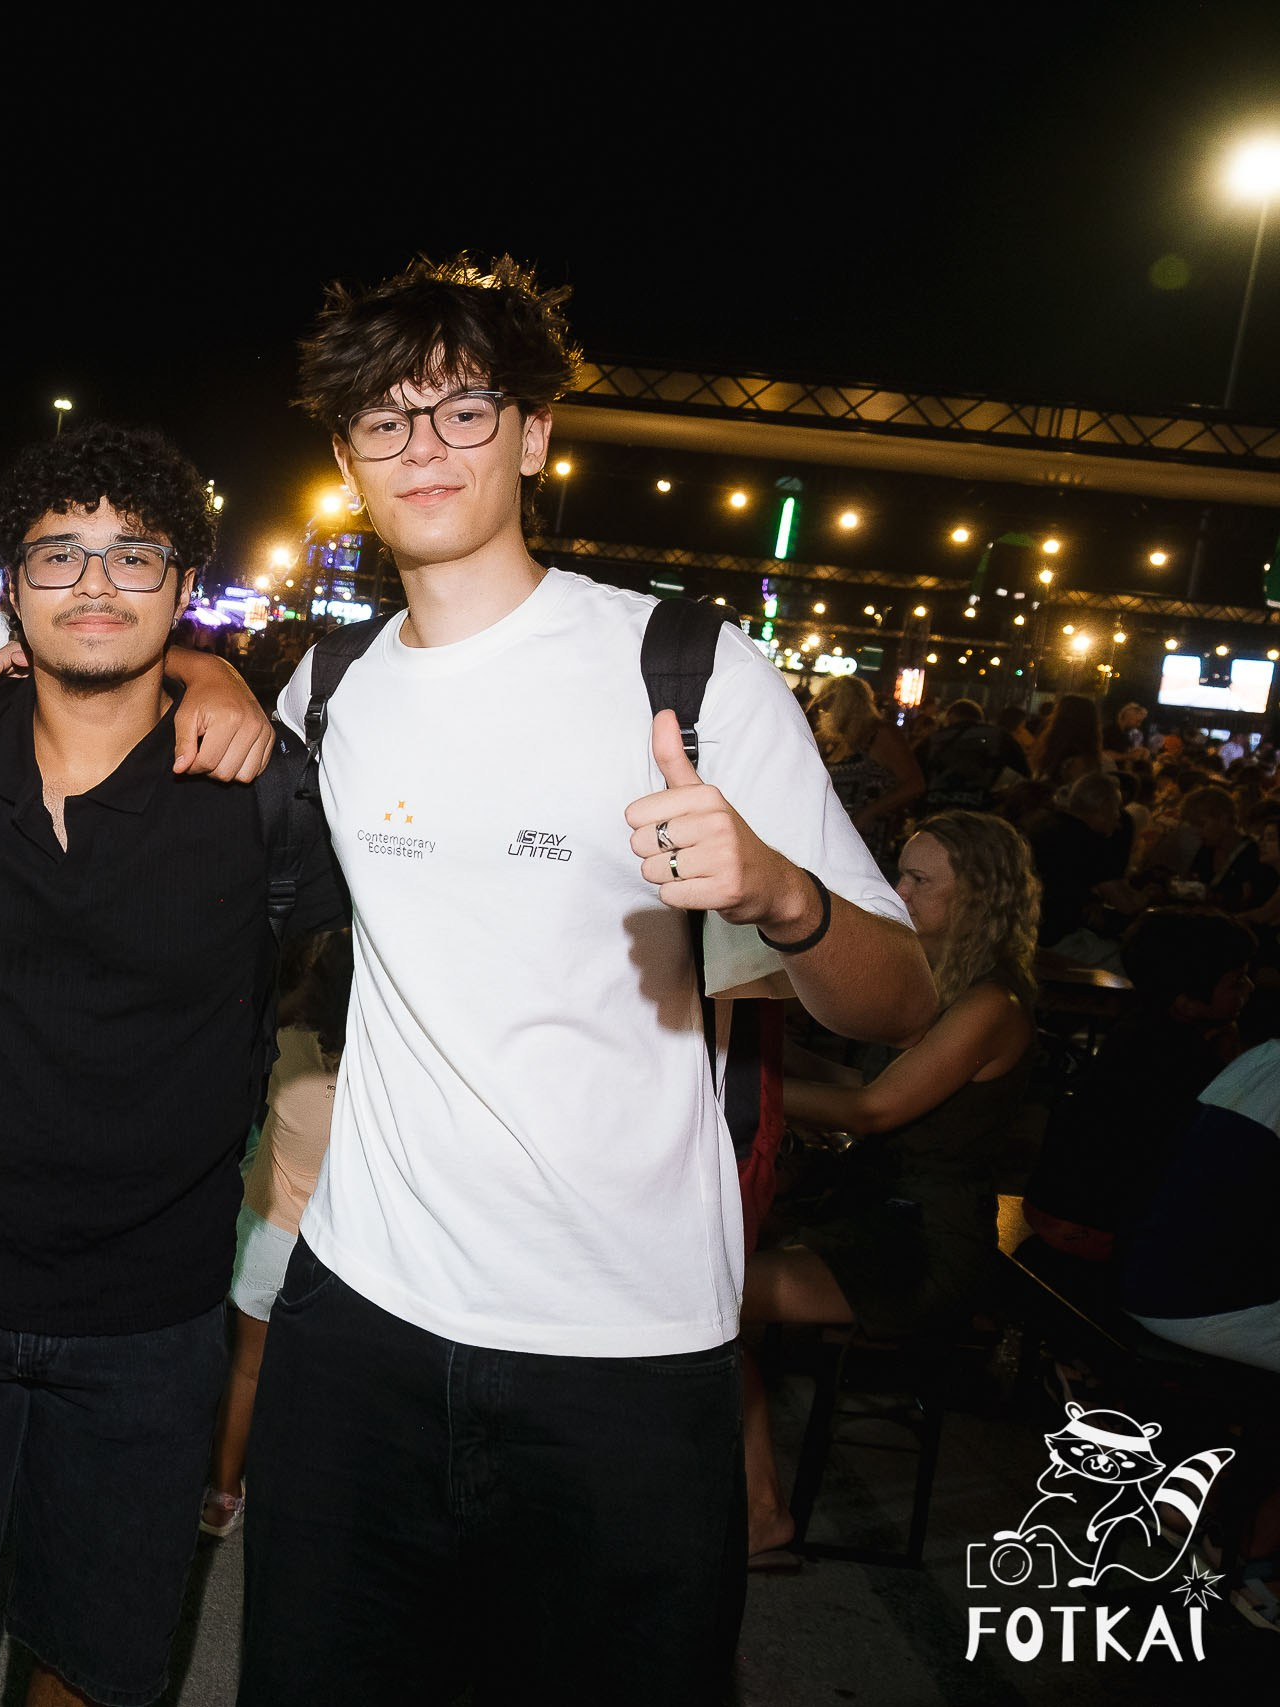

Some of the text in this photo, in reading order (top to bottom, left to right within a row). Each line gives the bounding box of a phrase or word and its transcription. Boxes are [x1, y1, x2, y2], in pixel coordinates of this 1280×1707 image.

[357, 829, 436, 853] Contemporary
[368, 841, 424, 860] Ecosistem
[508, 843, 572, 862] UNITED
